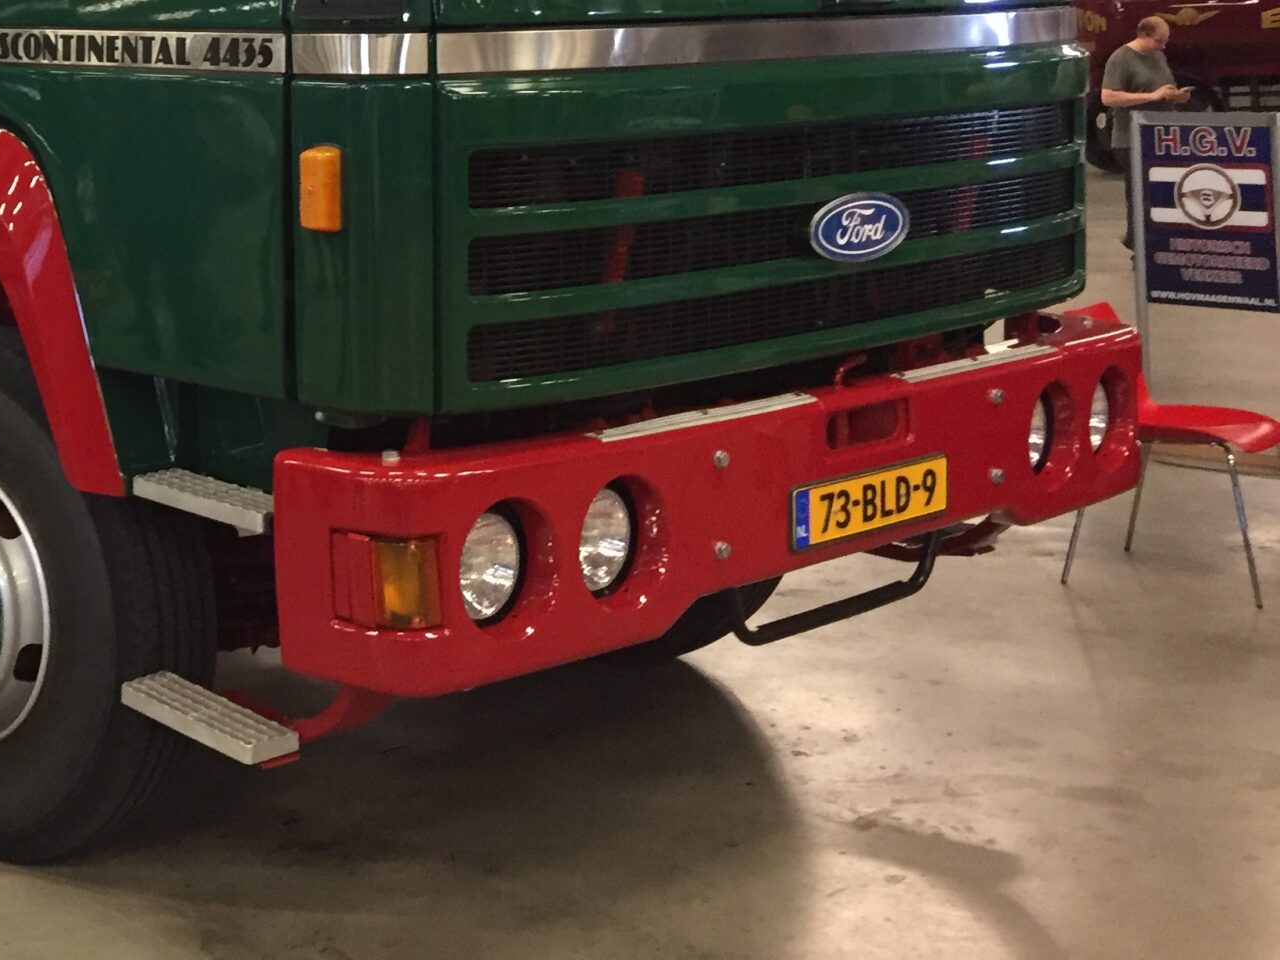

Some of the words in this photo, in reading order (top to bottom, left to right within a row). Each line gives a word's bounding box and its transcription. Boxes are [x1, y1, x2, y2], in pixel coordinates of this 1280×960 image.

[202, 37, 273, 68] 4435
[1154, 126, 1257, 157] H.G.V.
[836, 208, 886, 245] Ford
[820, 468, 936, 534] 73-BLD-9
